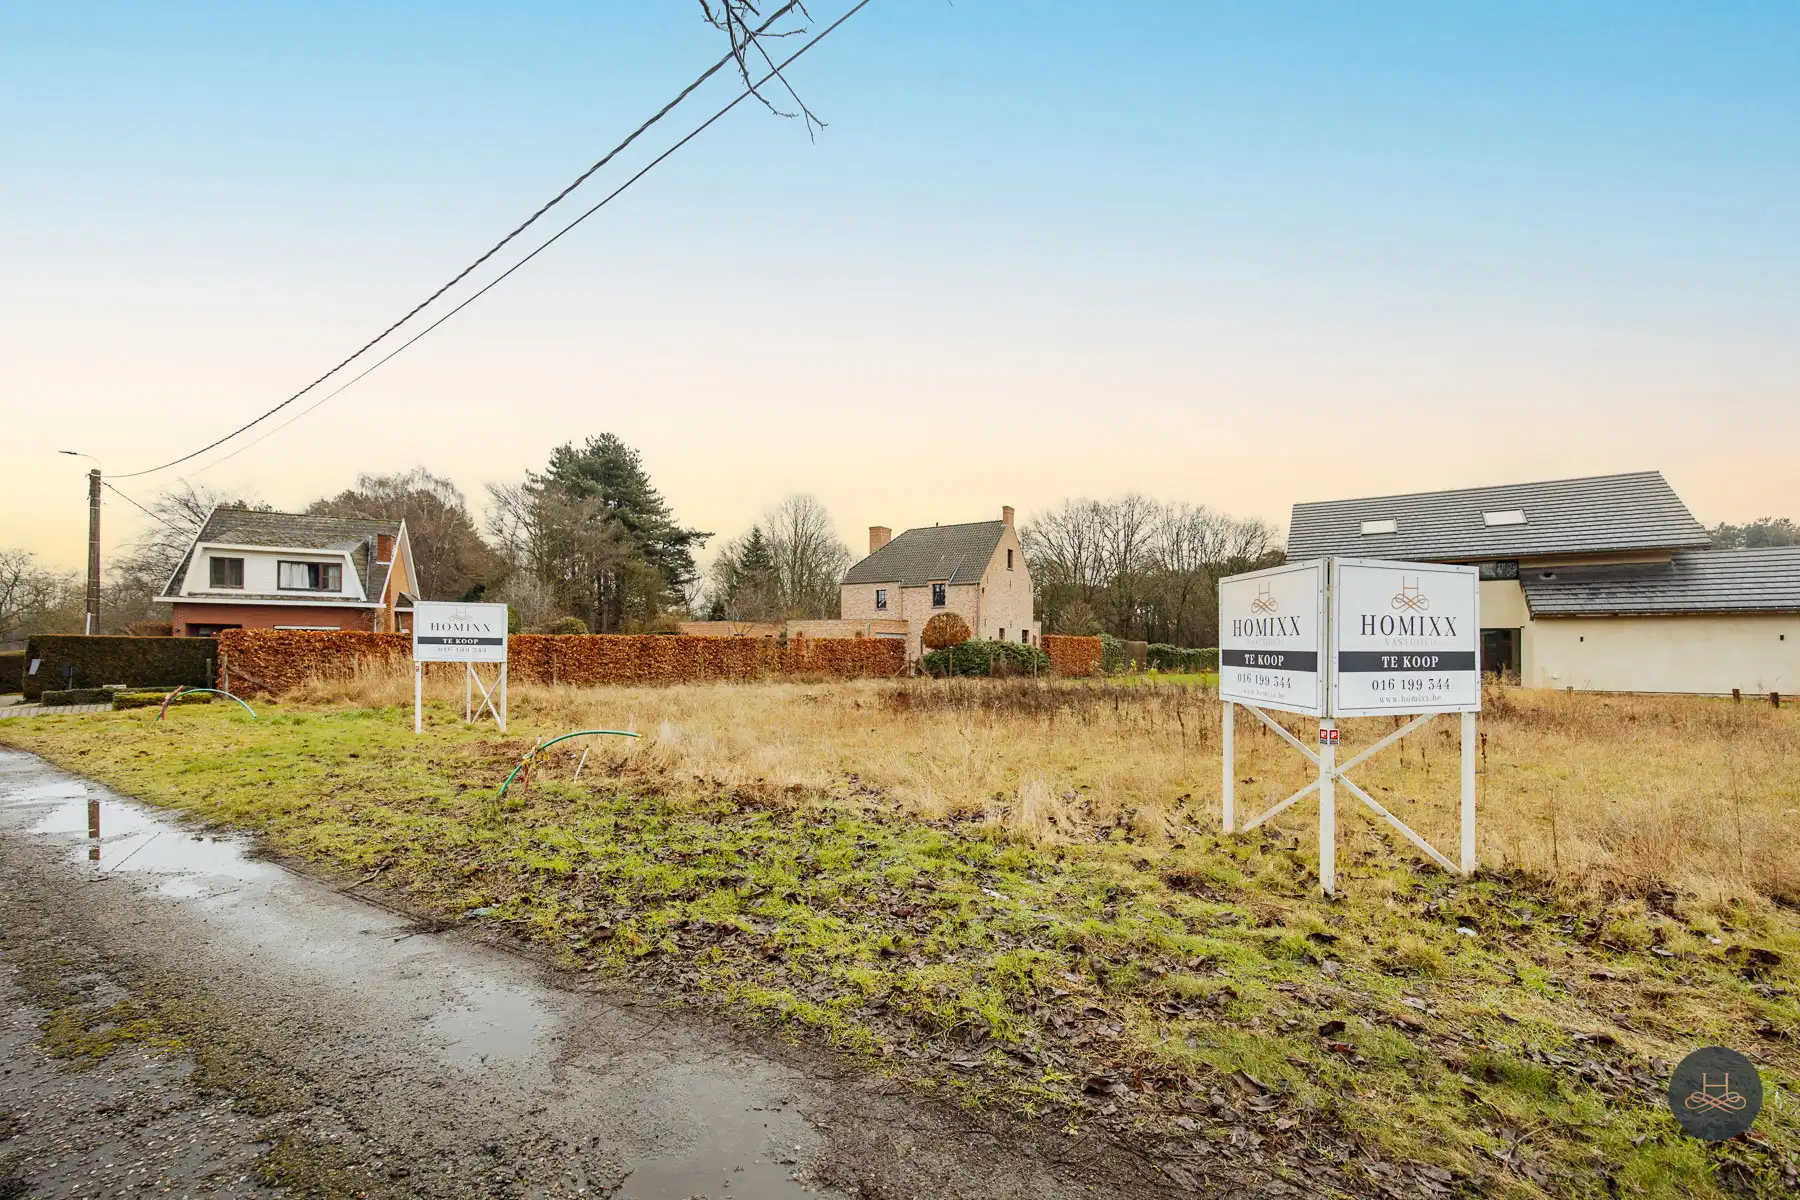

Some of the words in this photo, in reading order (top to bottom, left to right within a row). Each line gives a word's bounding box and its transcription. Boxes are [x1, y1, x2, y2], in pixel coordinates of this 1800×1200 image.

[430, 622, 491, 632] HOMIXX
[1232, 615, 1301, 637] HOMIXX
[1360, 614, 1457, 637] HOMIXX
[1244, 653, 1255, 665] TE
[1257, 654, 1284, 666] KOOP
[1381, 656, 1398, 668] TE
[1402, 655, 1439, 668] KOOP
[1237, 672, 1252, 684] 016
[1255, 674, 1270, 686] 199
[1372, 678, 1395, 691] 016
[1401, 678, 1423, 691] 199
[1428, 678, 1450, 690] 344
